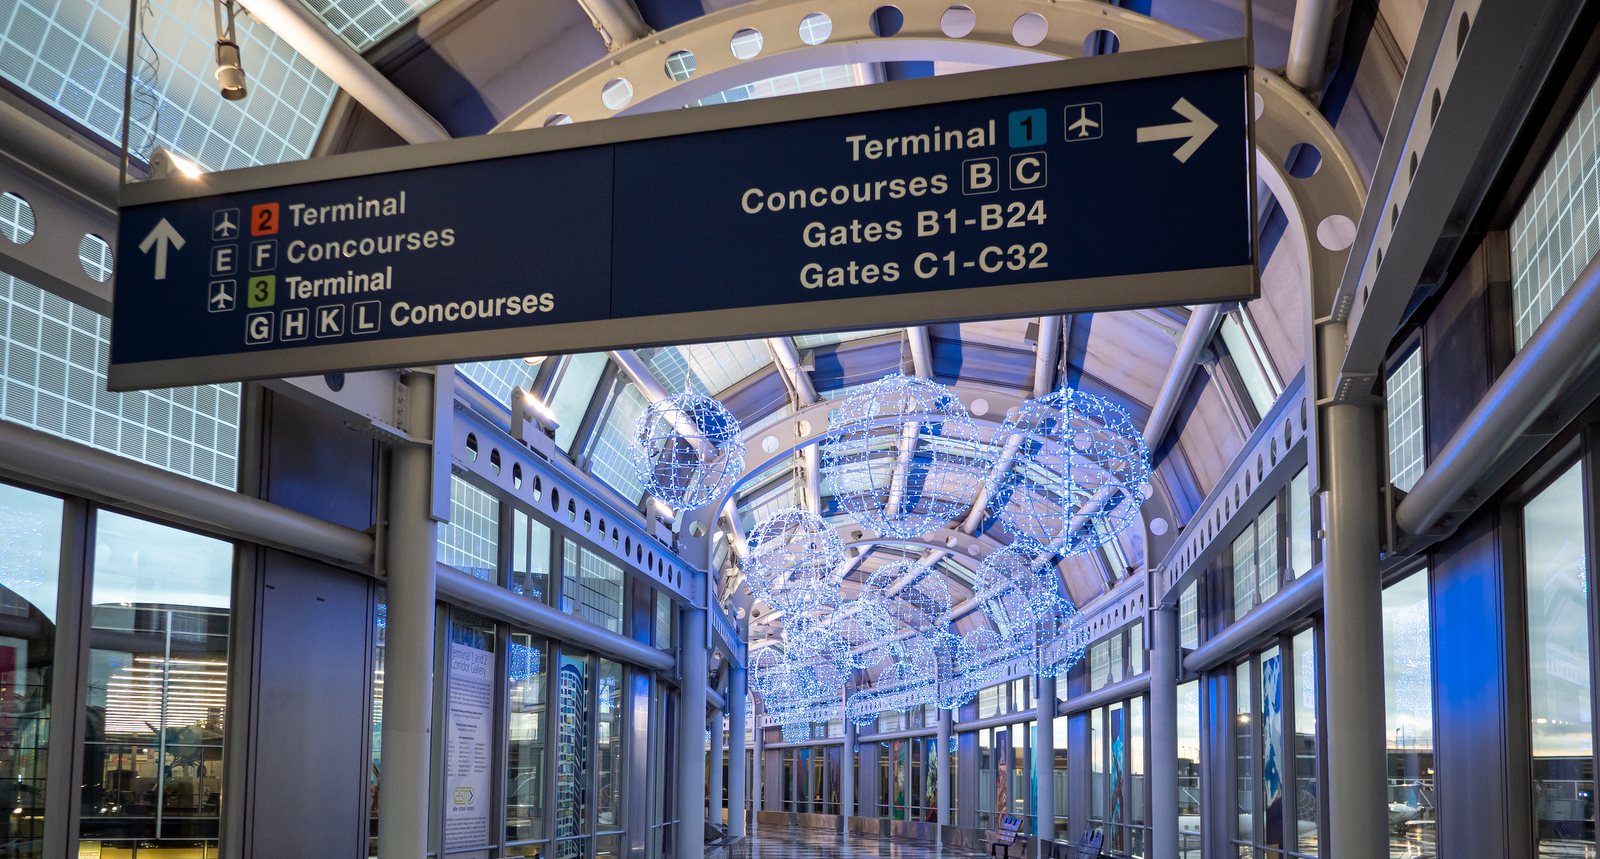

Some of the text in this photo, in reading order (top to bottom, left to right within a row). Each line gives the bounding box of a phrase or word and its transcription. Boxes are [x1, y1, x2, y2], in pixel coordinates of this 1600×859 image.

[846, 116, 1033, 162] Terminal 1
[741, 157, 1041, 214] Concourses B C
[258, 190, 406, 231] 2 Terminal
[802, 199, 1048, 248] Gates B1-B24
[216, 228, 455, 272] E F Concourses
[799, 242, 1049, 289] Gates C1-C32
[254, 265, 393, 302] 3 Terminal
[250, 292, 555, 340] G H K L Concourses
[471, 662, 487, 678] Gallery
